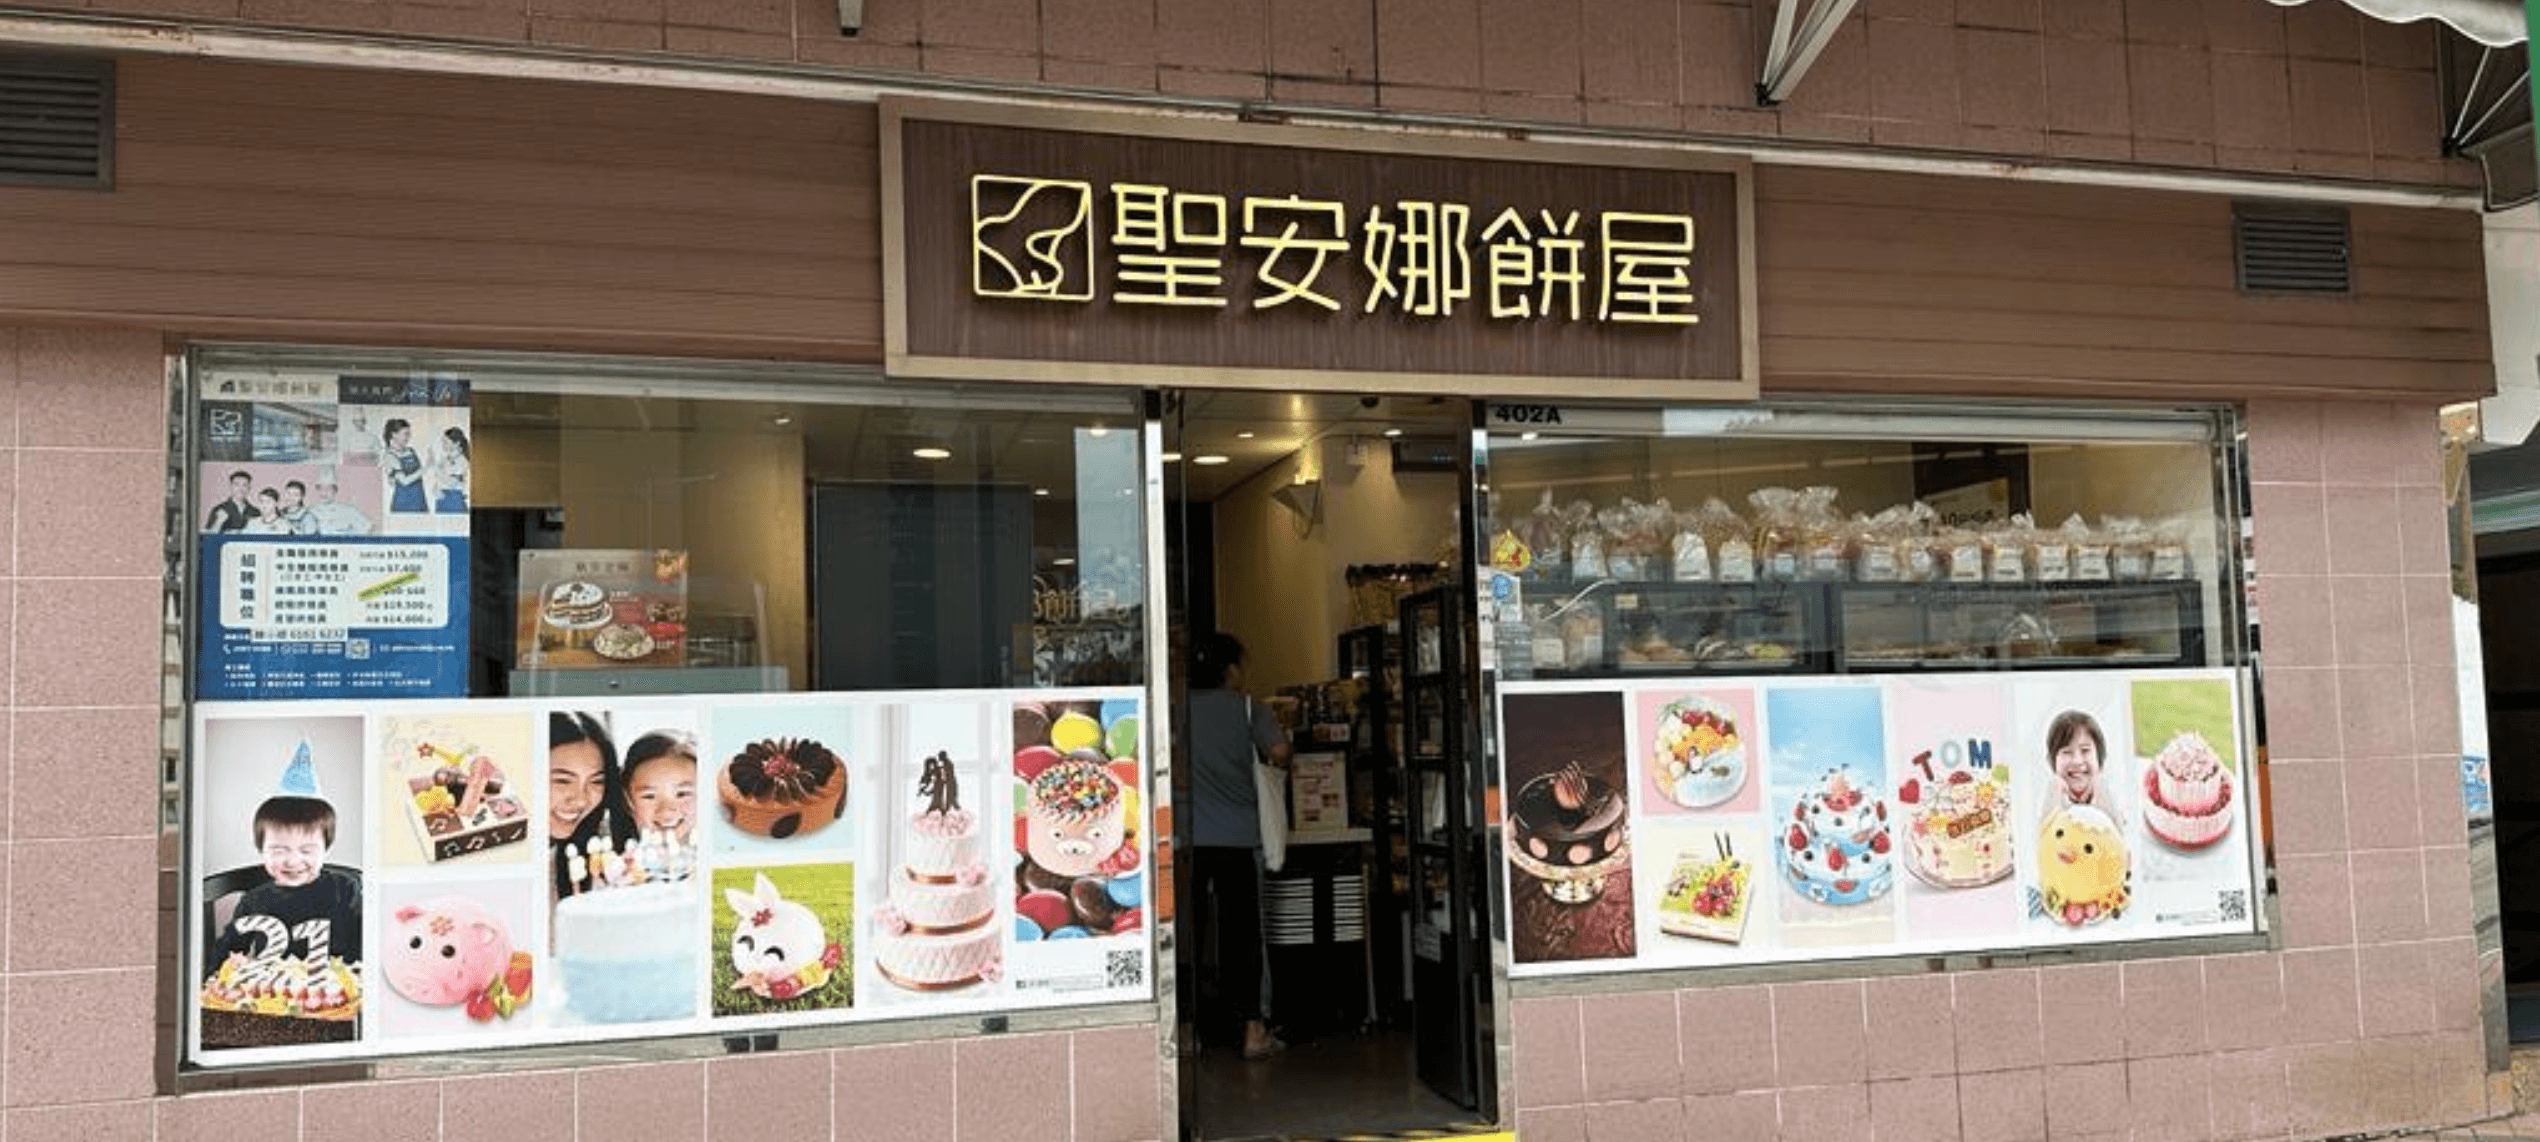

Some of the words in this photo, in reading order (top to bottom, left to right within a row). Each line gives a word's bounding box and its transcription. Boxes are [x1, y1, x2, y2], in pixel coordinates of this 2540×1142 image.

[1110, 183, 1699, 322] 聖安娜餅屋
[1495, 404, 1562, 424] 402A
[1912, 738, 1993, 782] TOM
[234, 914, 332, 989] 21
